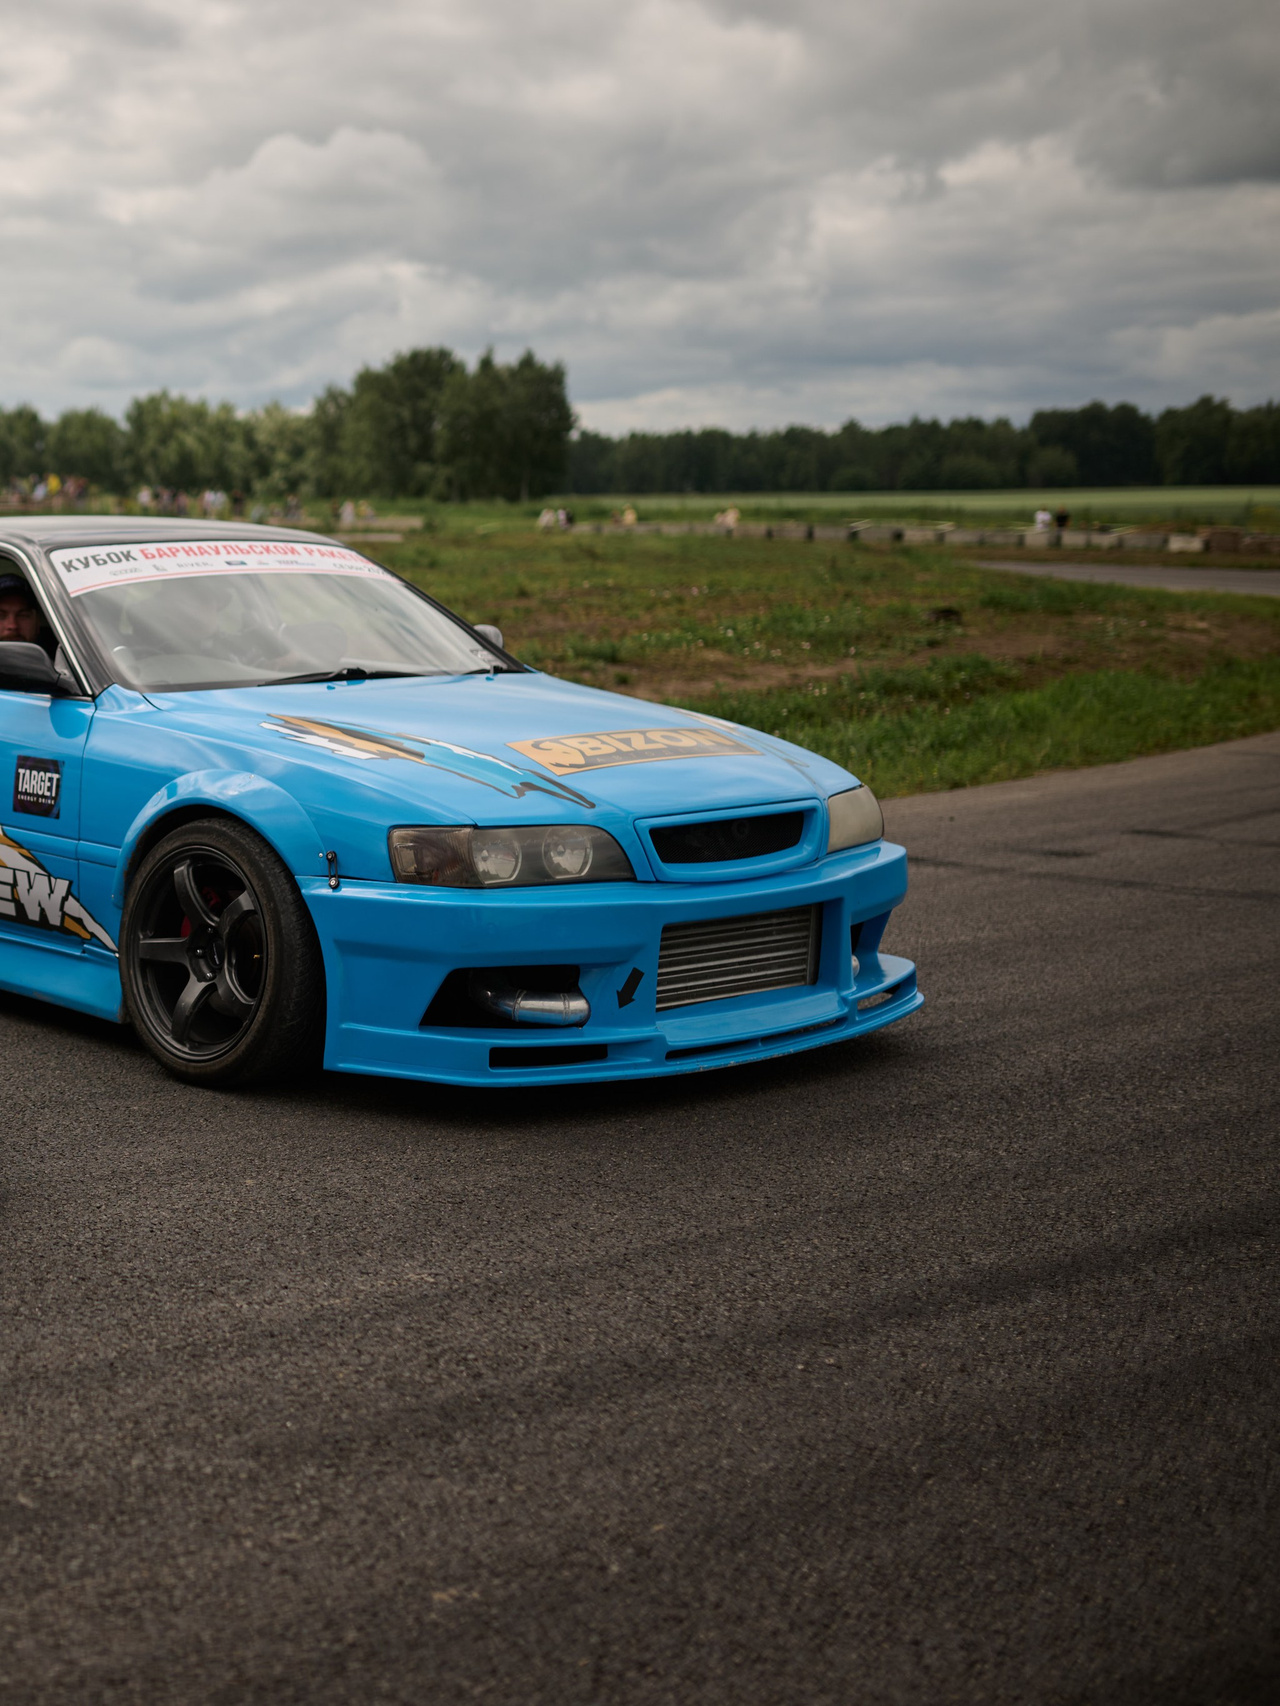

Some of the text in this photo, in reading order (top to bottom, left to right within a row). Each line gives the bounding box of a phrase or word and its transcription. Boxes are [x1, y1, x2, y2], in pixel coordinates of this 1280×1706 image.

[60, 549, 138, 574] КУБОК
[140, 542, 301, 560] БАРНАУЛЬСКОЙ
[570, 731, 736, 757] BIZON
[18, 768, 61, 798] TARGET
